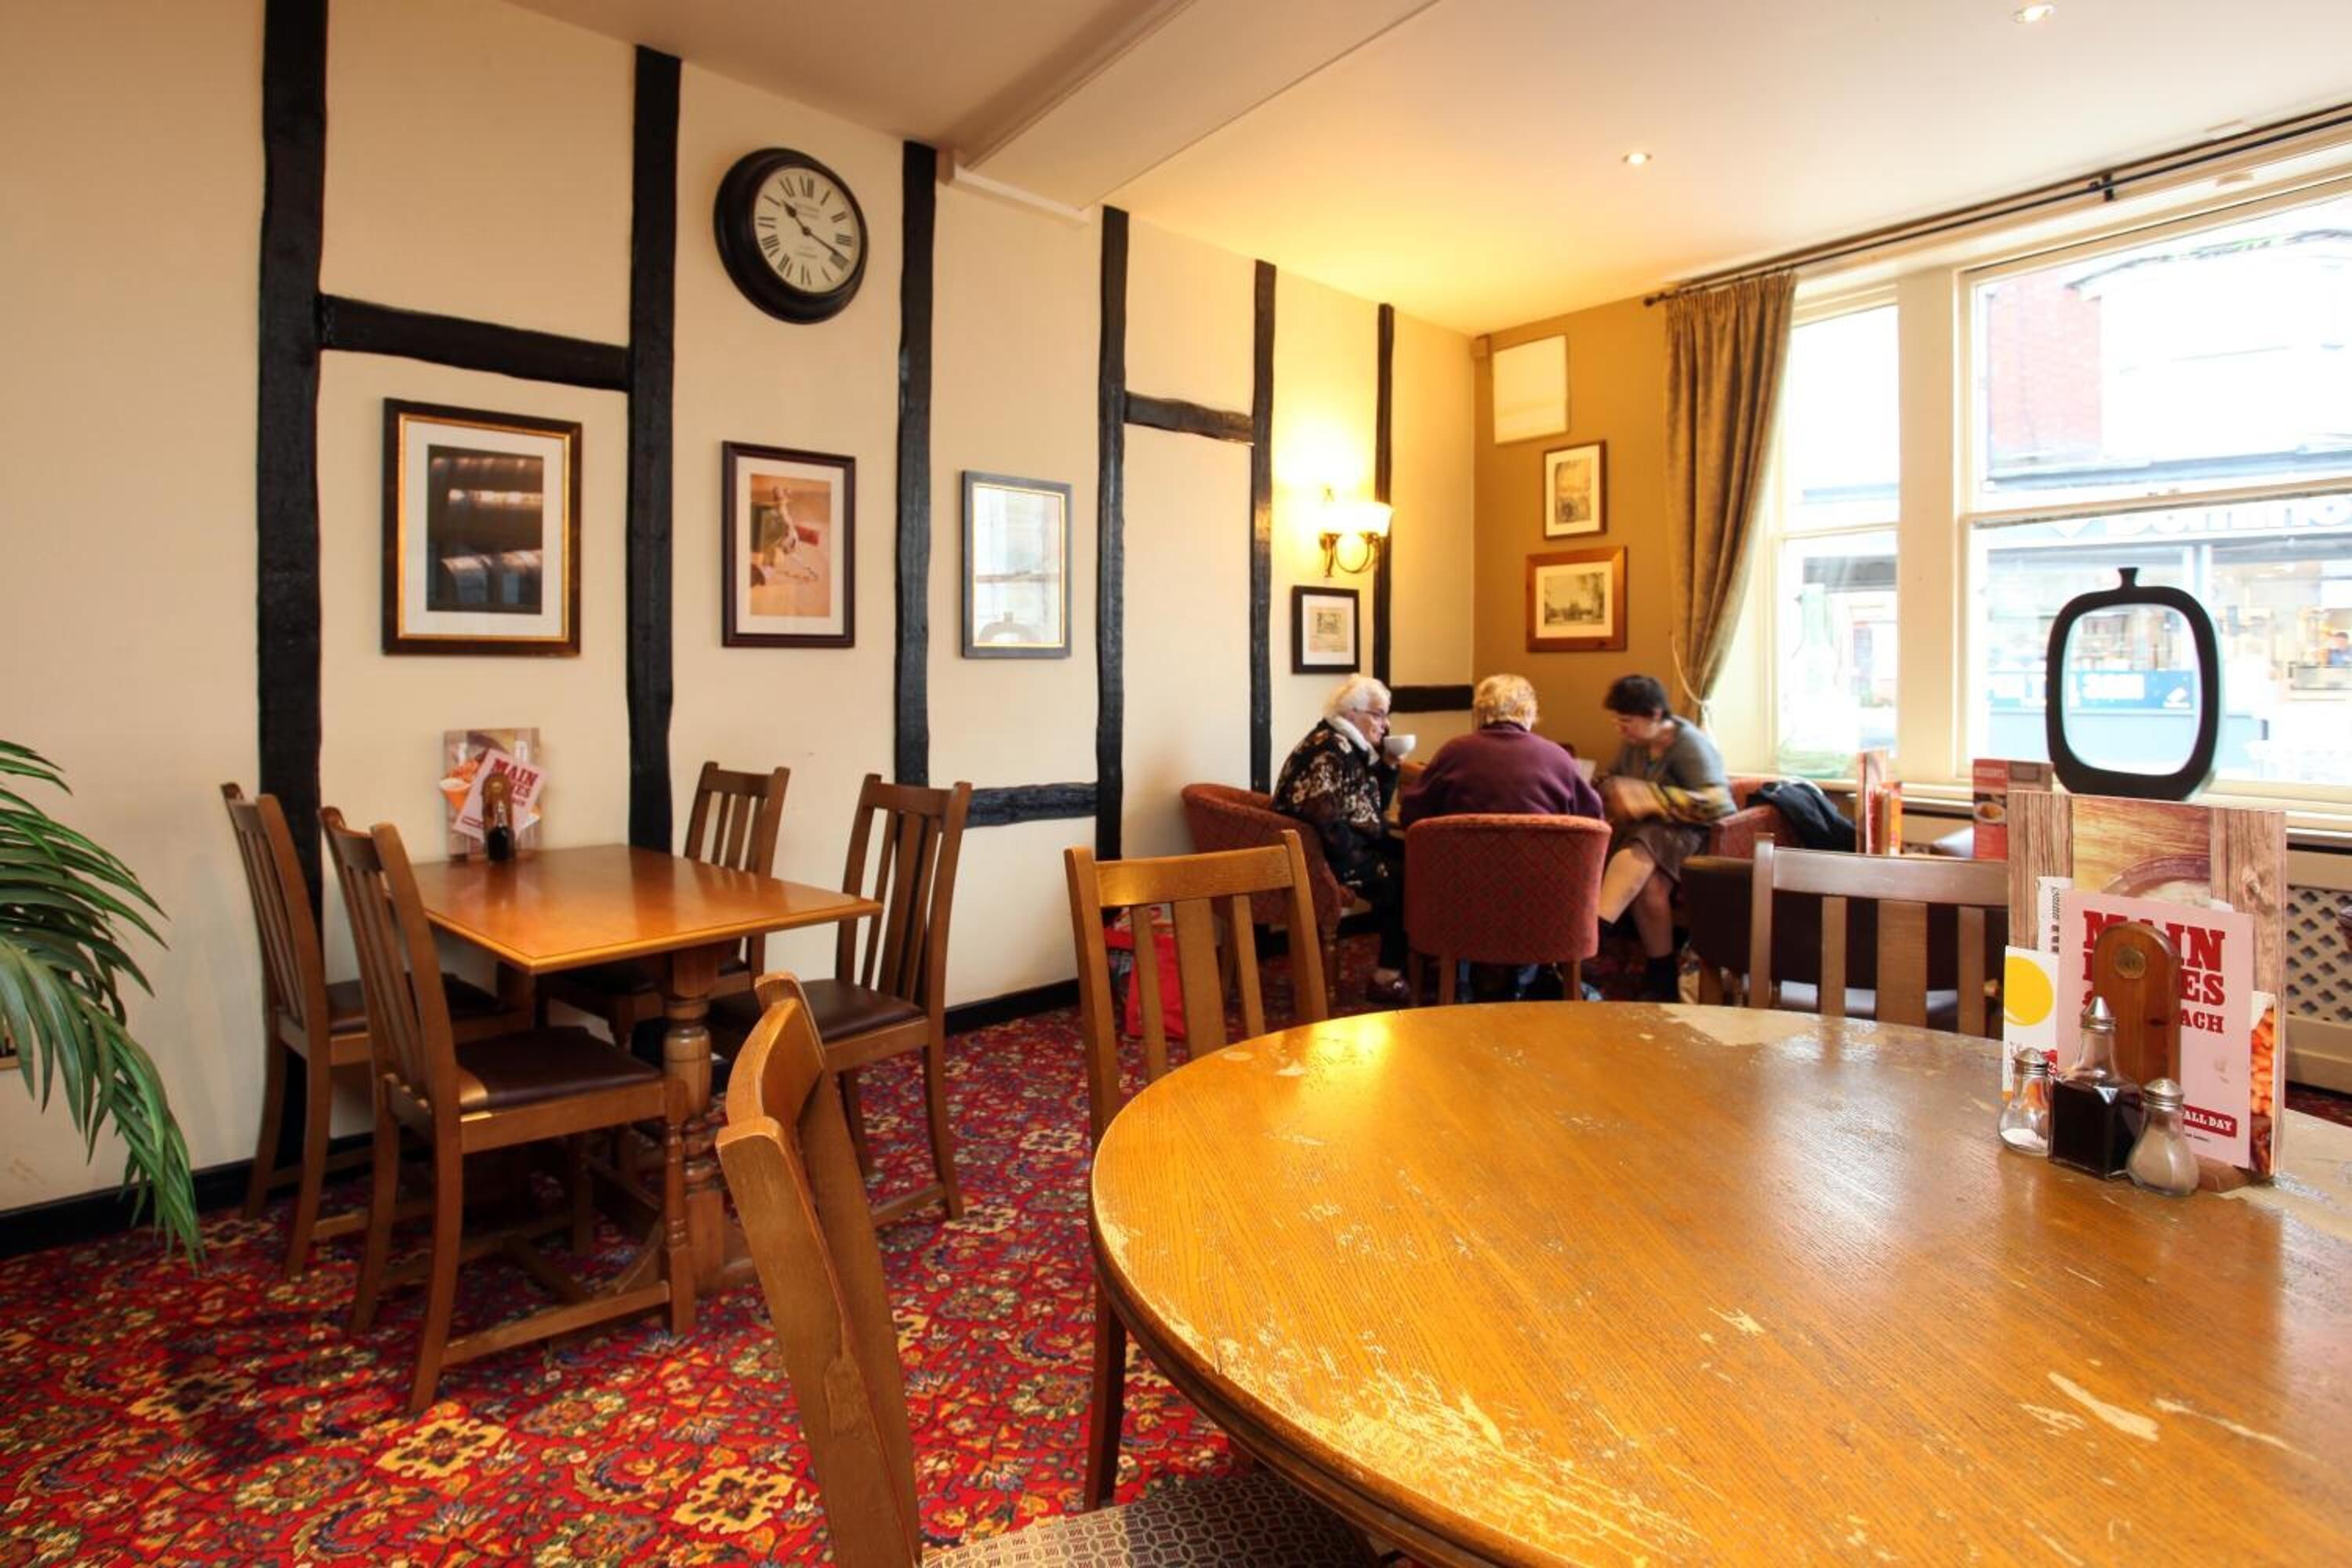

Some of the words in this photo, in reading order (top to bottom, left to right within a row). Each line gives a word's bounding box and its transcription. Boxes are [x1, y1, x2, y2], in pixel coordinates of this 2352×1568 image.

[2082, 911, 2226, 972] MIN
[2180, 1010, 2224, 1034] ACH
[2183, 1109, 2206, 1125] ALL
[2208, 1116, 2232, 1131] DAY
